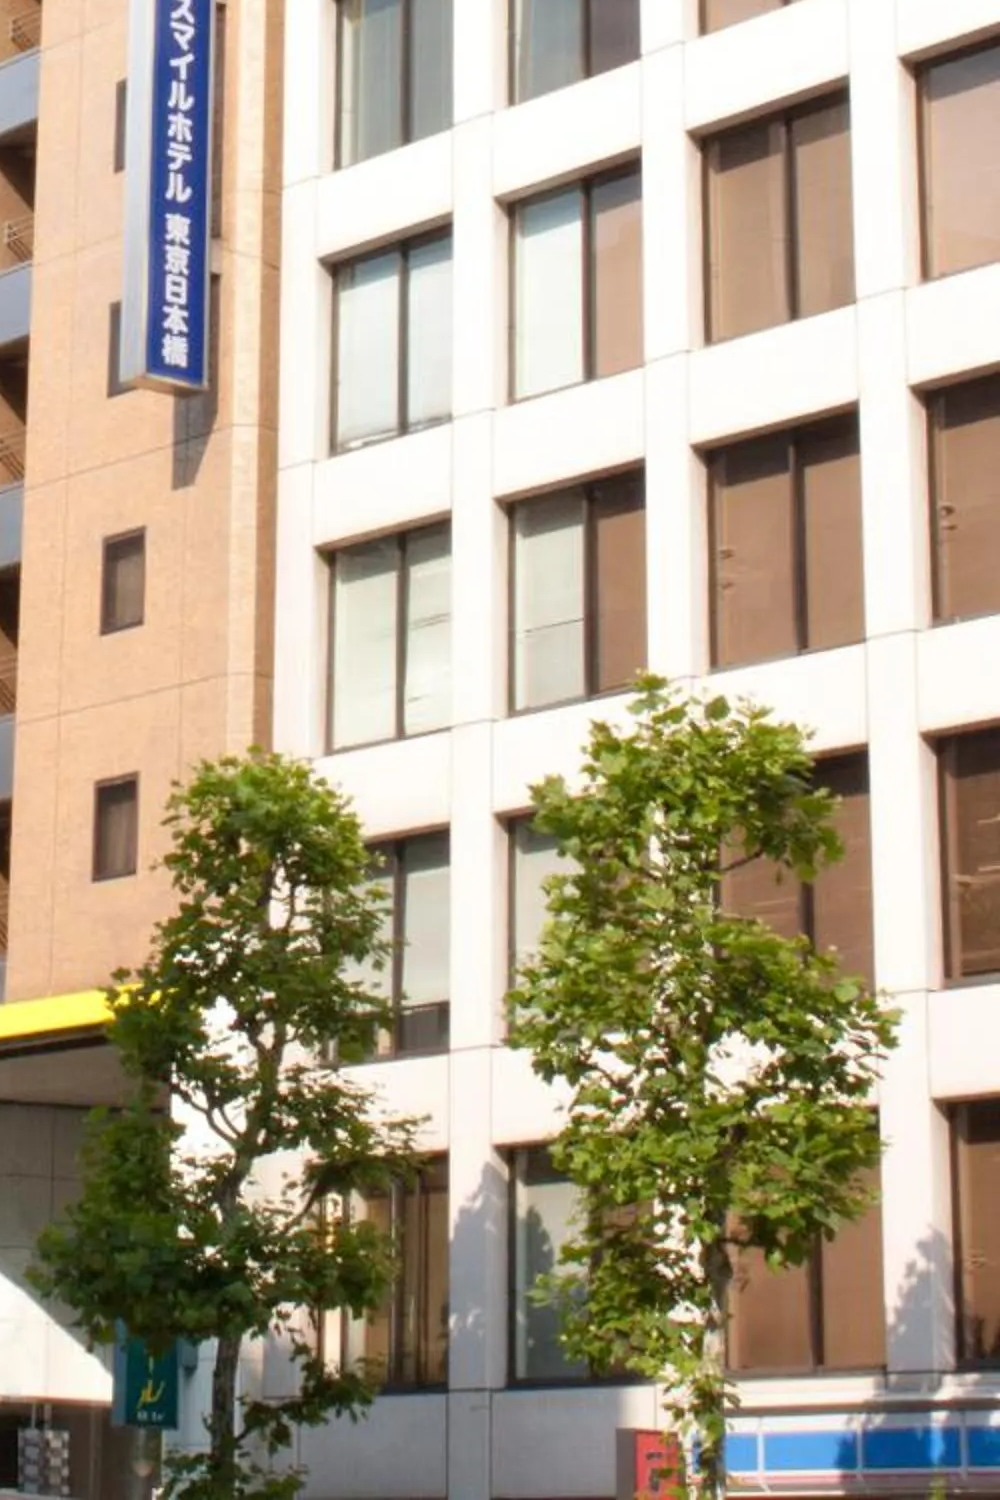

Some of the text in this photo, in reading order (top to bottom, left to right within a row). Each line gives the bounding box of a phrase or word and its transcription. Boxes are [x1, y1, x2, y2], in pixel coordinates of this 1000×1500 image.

[162, 212, 191, 369] 東京日本橋
